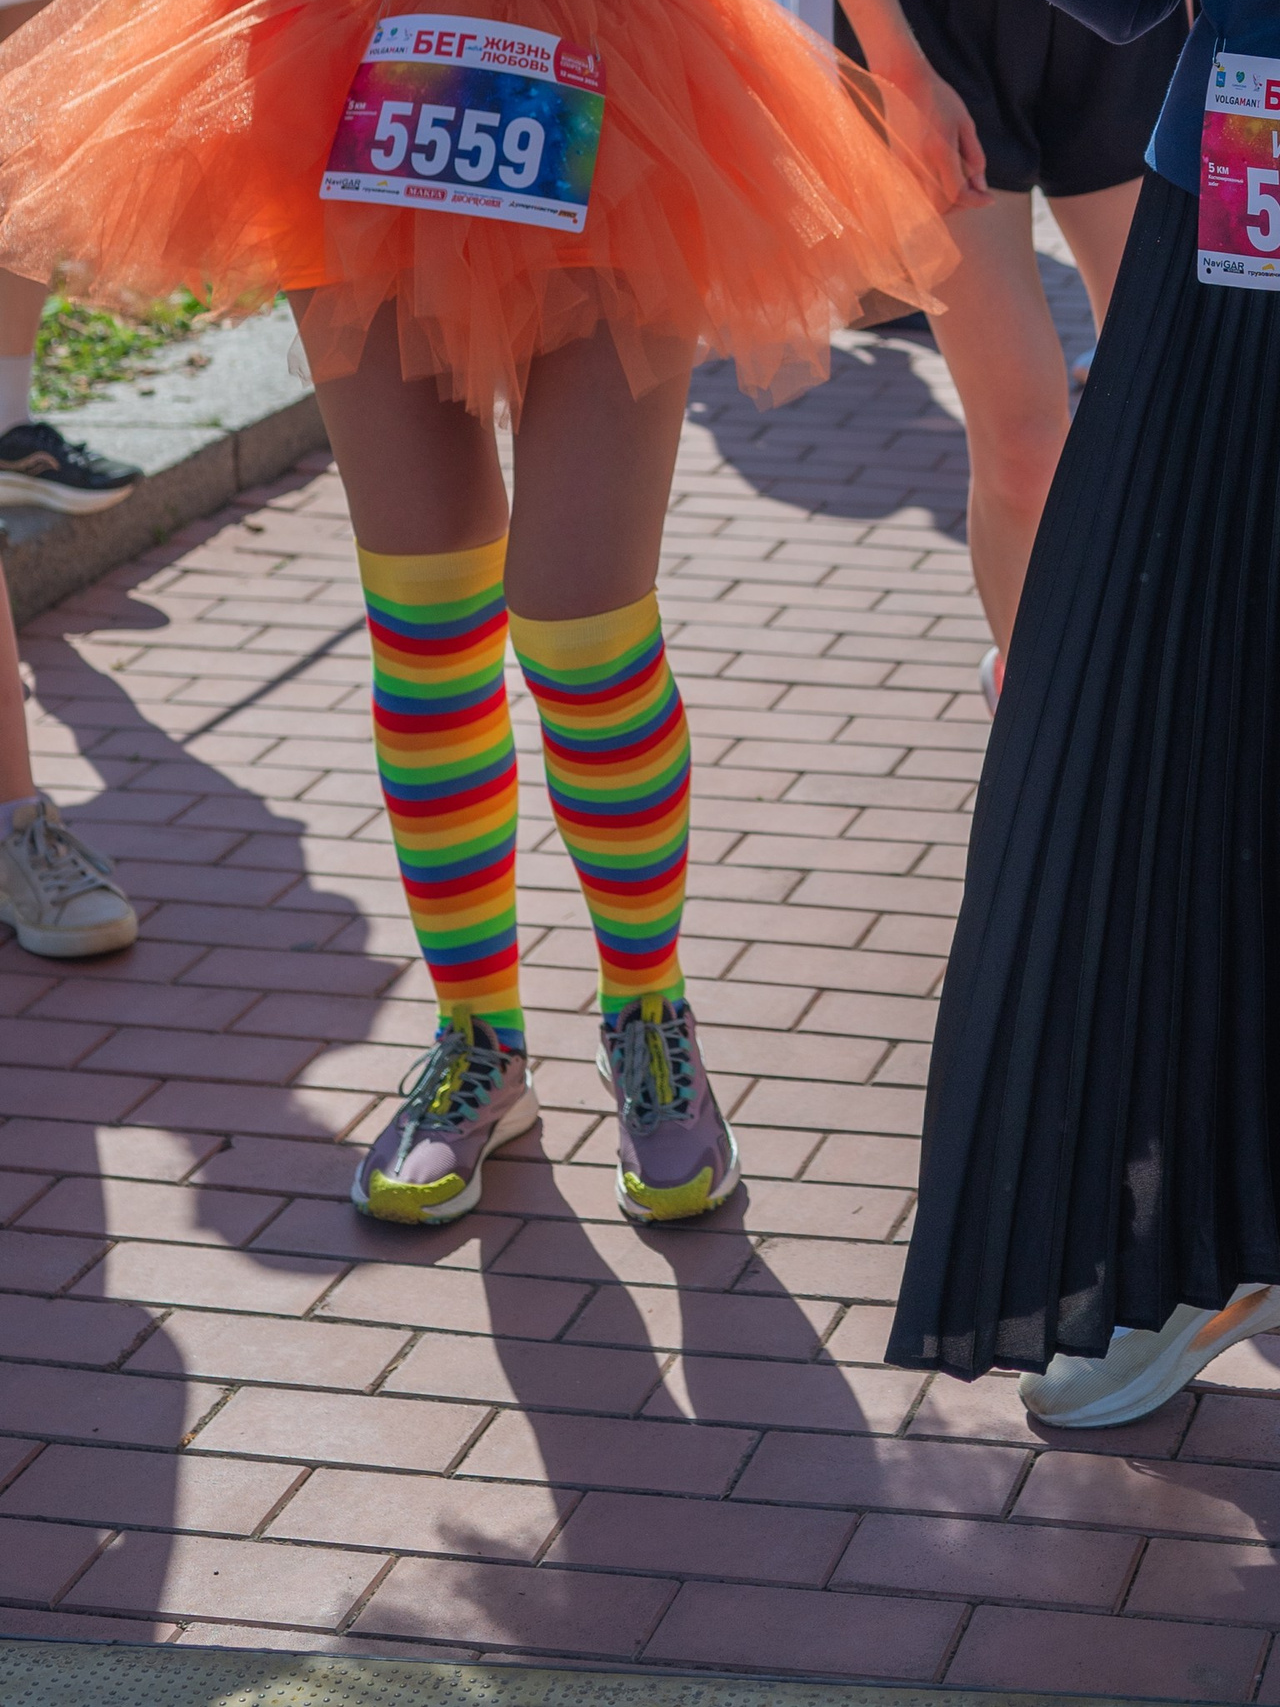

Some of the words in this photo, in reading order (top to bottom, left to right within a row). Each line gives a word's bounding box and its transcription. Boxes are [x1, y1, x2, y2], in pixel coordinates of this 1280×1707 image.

[412, 30, 477, 58] БЕГ
[483, 36, 551, 61] ЖИЗНЬ
[480, 51, 549, 73] ЛЮБОВЬ
[1215, 94, 1257, 108] VOLGAMAN
[370, 100, 545, 189] 5559
[1208, 162, 1215, 173] 5
[1203, 257, 1245, 271] NaviGAR
